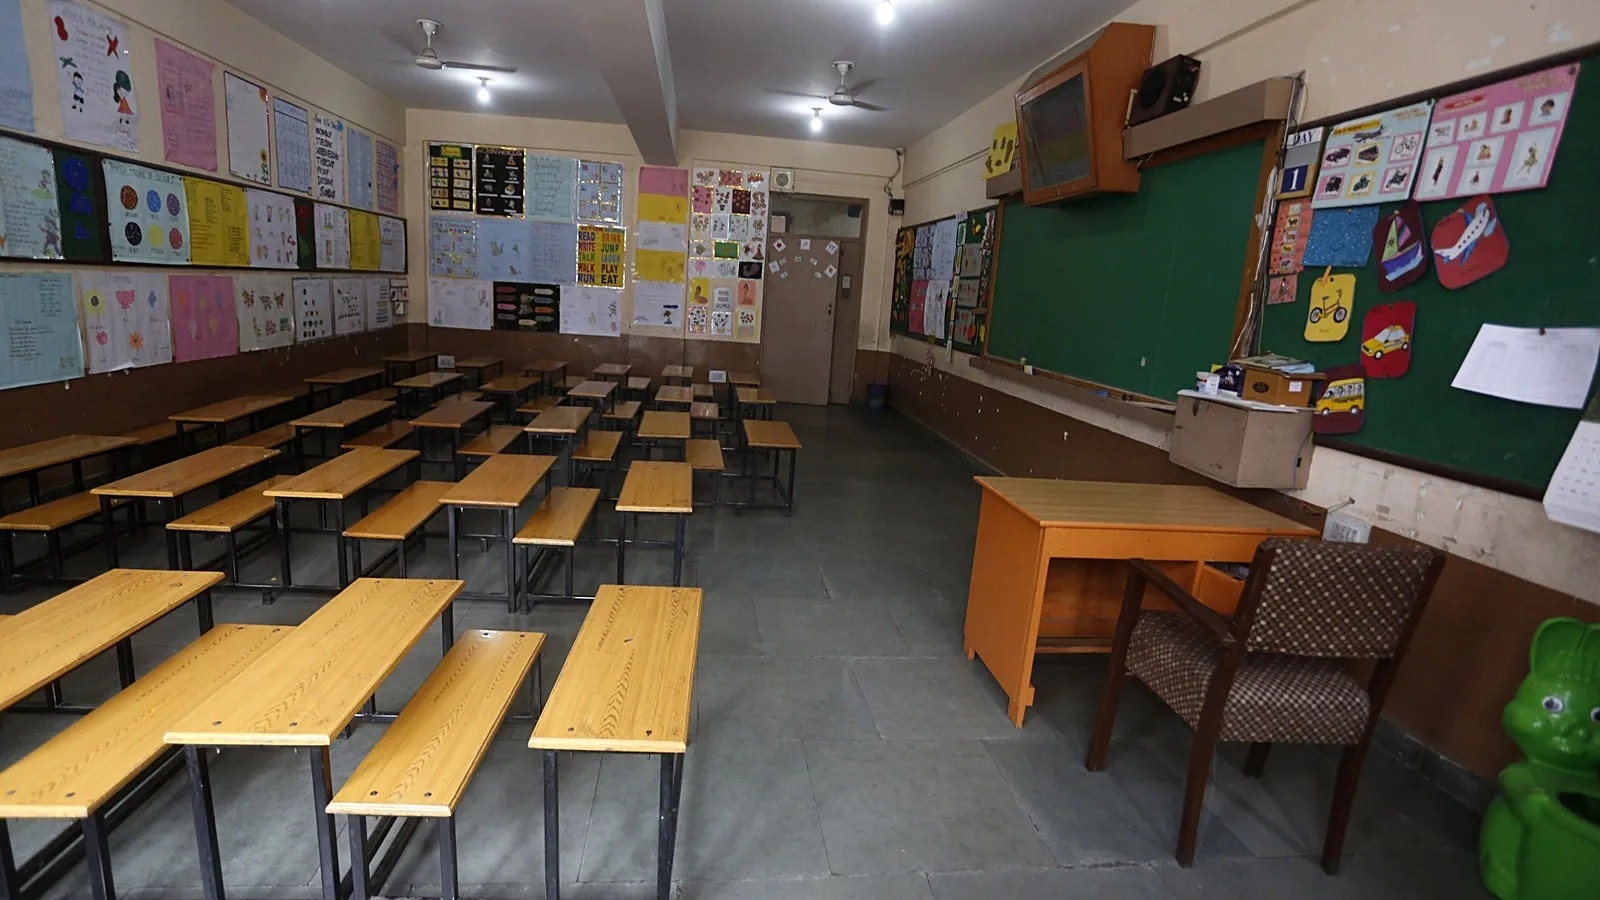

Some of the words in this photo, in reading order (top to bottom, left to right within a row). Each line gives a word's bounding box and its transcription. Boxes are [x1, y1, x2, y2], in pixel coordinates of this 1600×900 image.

[1292, 131, 1312, 146] DAY
[1289, 168, 1299, 191] 1
[578, 231, 596, 242] READ
[601, 233, 622, 244] DRINK
[578, 241, 596, 252] WRITE
[601, 243, 620, 254] JUMP
[578, 252, 596, 263] TALK
[578, 262, 595, 273] WALK
[601, 264, 620, 274] PLAY
[577, 273, 595, 284] RUN
[601, 274, 619, 285] EAT
